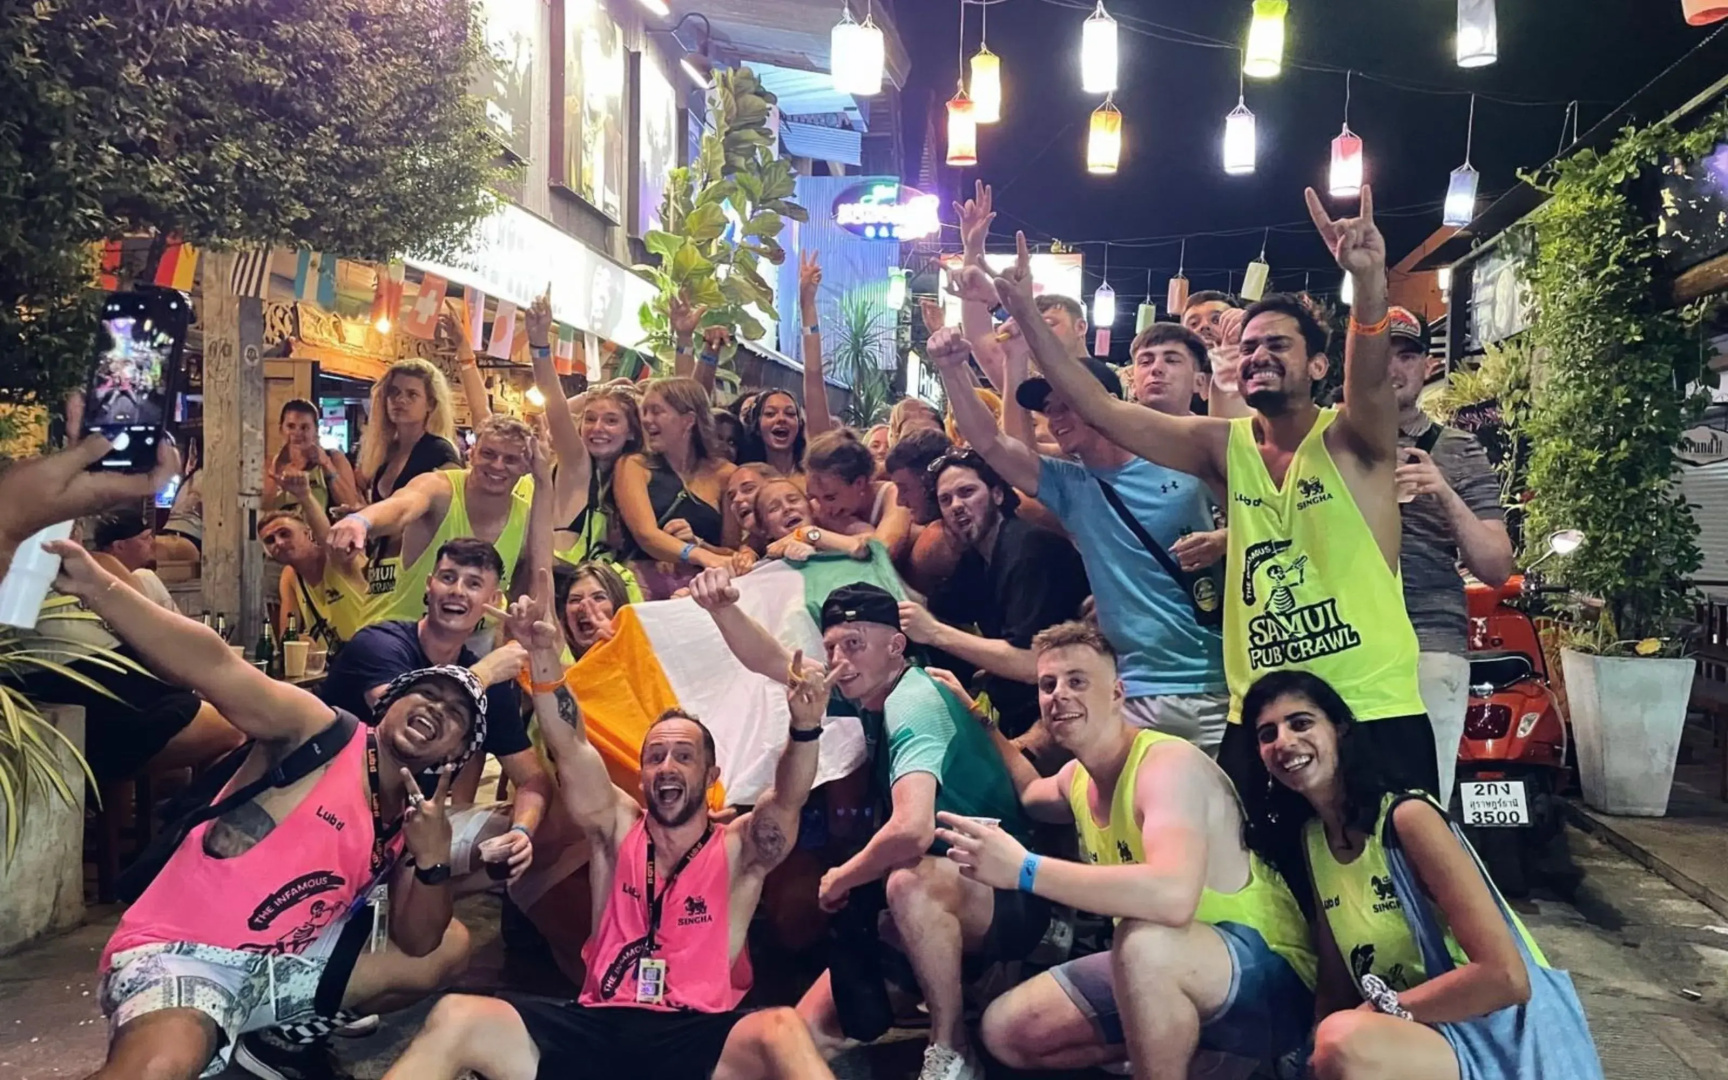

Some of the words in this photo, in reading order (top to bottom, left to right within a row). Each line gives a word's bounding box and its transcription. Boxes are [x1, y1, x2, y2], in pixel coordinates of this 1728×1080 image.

[1296, 493, 1334, 511] SINGHA
[1253, 603, 1340, 646] SAMUI
[1250, 645, 1284, 668] PUB
[1286, 630, 1358, 660] CRAWL
[1474, 783, 1511, 796] 2กง
[1472, 811, 1520, 824] 3500
[253, 905, 274, 925] THE
[274, 876, 328, 908] INFAMOUS
[677, 914, 713, 927] SINGHA
[603, 975, 617, 993] THE
